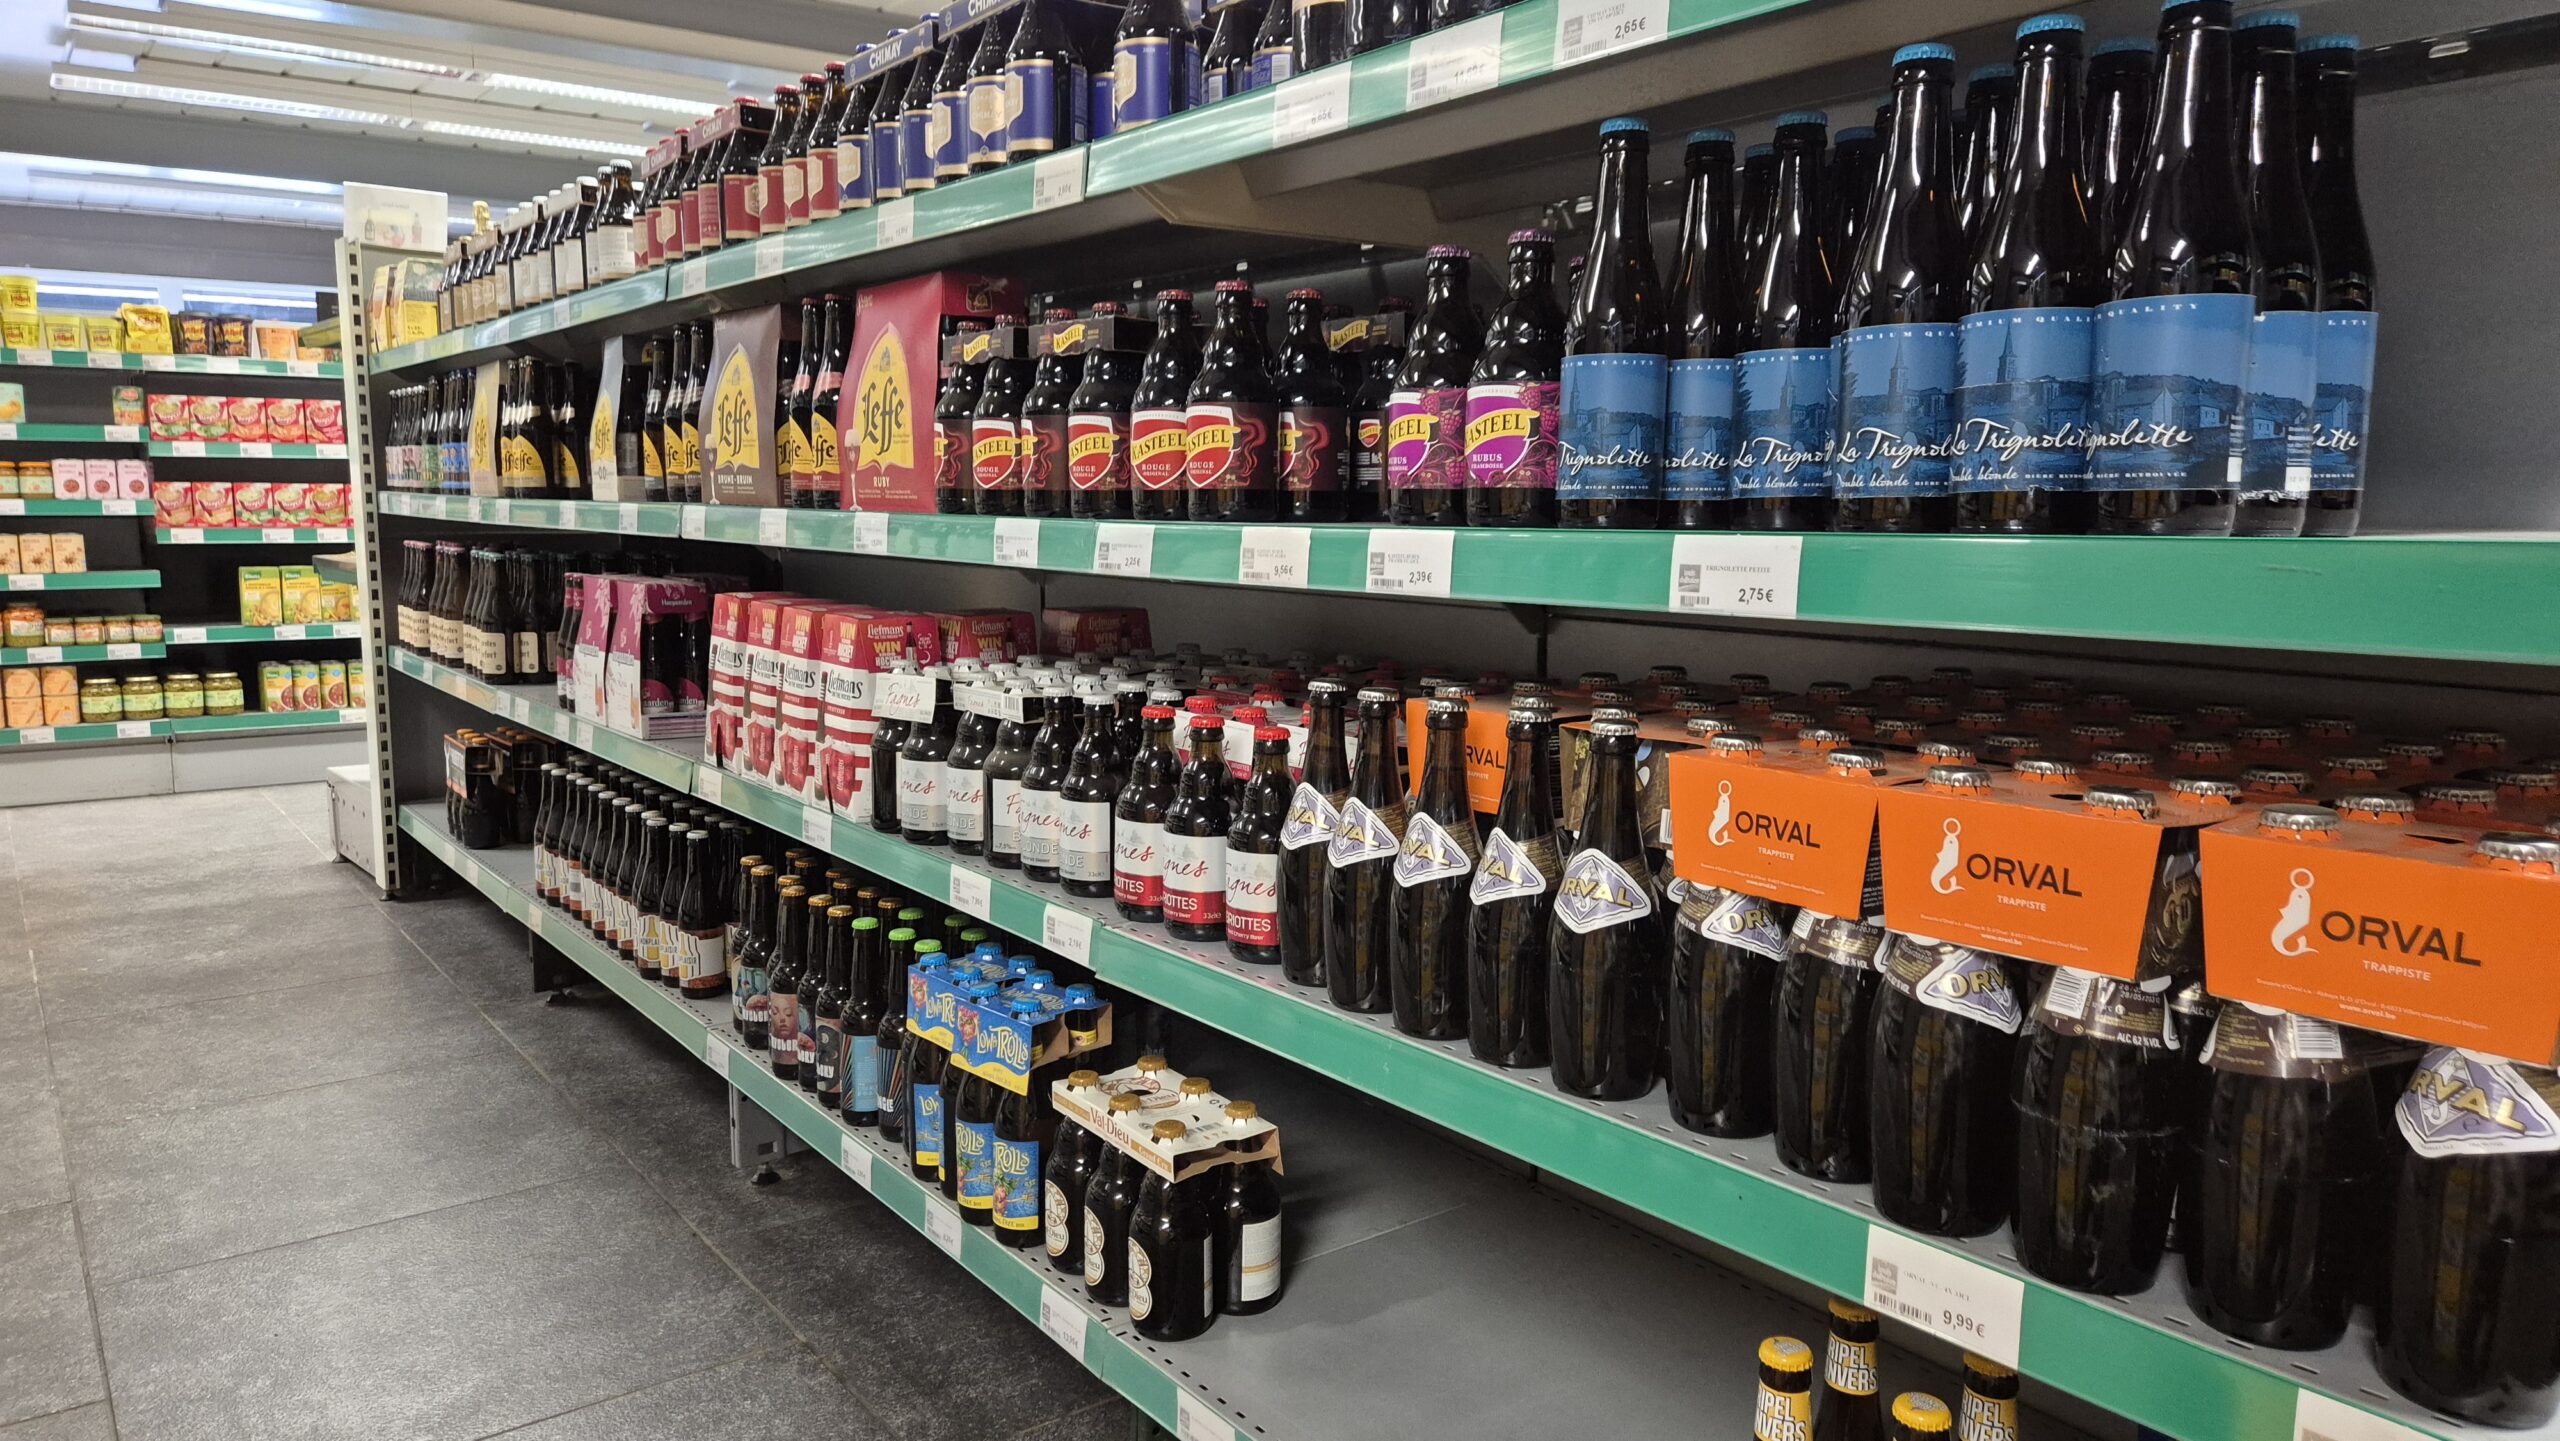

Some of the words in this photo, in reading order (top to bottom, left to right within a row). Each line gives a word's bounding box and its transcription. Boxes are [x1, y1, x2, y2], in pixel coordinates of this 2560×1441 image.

[1615, 17, 1646, 40] 2,65€
[869, 39, 902, 69] CHIMAY
[702, 121, 722, 137] CHIMAY
[2108, 303, 2199, 317] QUALITY
[1055, 326, 1083, 351] KASTEEL
[1333, 322, 1365, 347] KASTEEL
[718, 389, 752, 458] Leffe
[862, 376, 905, 456] Leffe
[1188, 429, 1230, 454] ASTEEL
[1390, 419, 1427, 441] STEEL
[975, 441, 1014, 461] ASTEEL
[1070, 437, 1110, 460] ASTEEL
[1472, 453, 1503, 462] RUBUS
[1559, 441, 1651, 476] Trignolette
[1662, 447, 1729, 470] nolette
[1733, 440, 1756, 468] La
[1837, 432, 1861, 463] La
[1857, 427, 1951, 470] Trignol
[1142, 463, 1171, 471] ROUGE
[1977, 467, 2020, 480] blonde
[873, 476, 890, 488] RUBY
[1765, 475, 1800, 488] blonde
[1869, 472, 1911, 487] blonde
[1274, 565, 1294, 579] 9,56€
[1408, 570, 1433, 585] 2,39€
[1738, 587, 1774, 605] 2,75€
[795, 615, 811, 632] WIN
[840, 622, 856, 640] WIN
[868, 624, 904, 639] Liefmans
[972, 620, 1004, 634] Liefmans
[874, 641, 901, 653] WIN
[978, 637, 1001, 648] WIN
[785, 660, 816, 688] Liefmans
[828, 670, 864, 699] Liefmans
[1735, 811, 1821, 849] ORVAL
[1757, 846, 1795, 861] TRAPPISTE
[1115, 878, 1145, 893] OTTES
[1967, 854, 2083, 897] ORVAL
[1562, 876, 1633, 908] RVAL
[1997, 895, 2047, 913] TRAPPISTE
[2321, 910, 2482, 967] ORVAL
[2362, 959, 2432, 982] TRAPPISTE
[2410, 1067, 2527, 1135] RVAL
[1943, 1309, 1985, 1339] 9,99€
[1754, 1416, 1807, 1441] NVERS
[1959, 1418, 2015, 1441] NVERS
